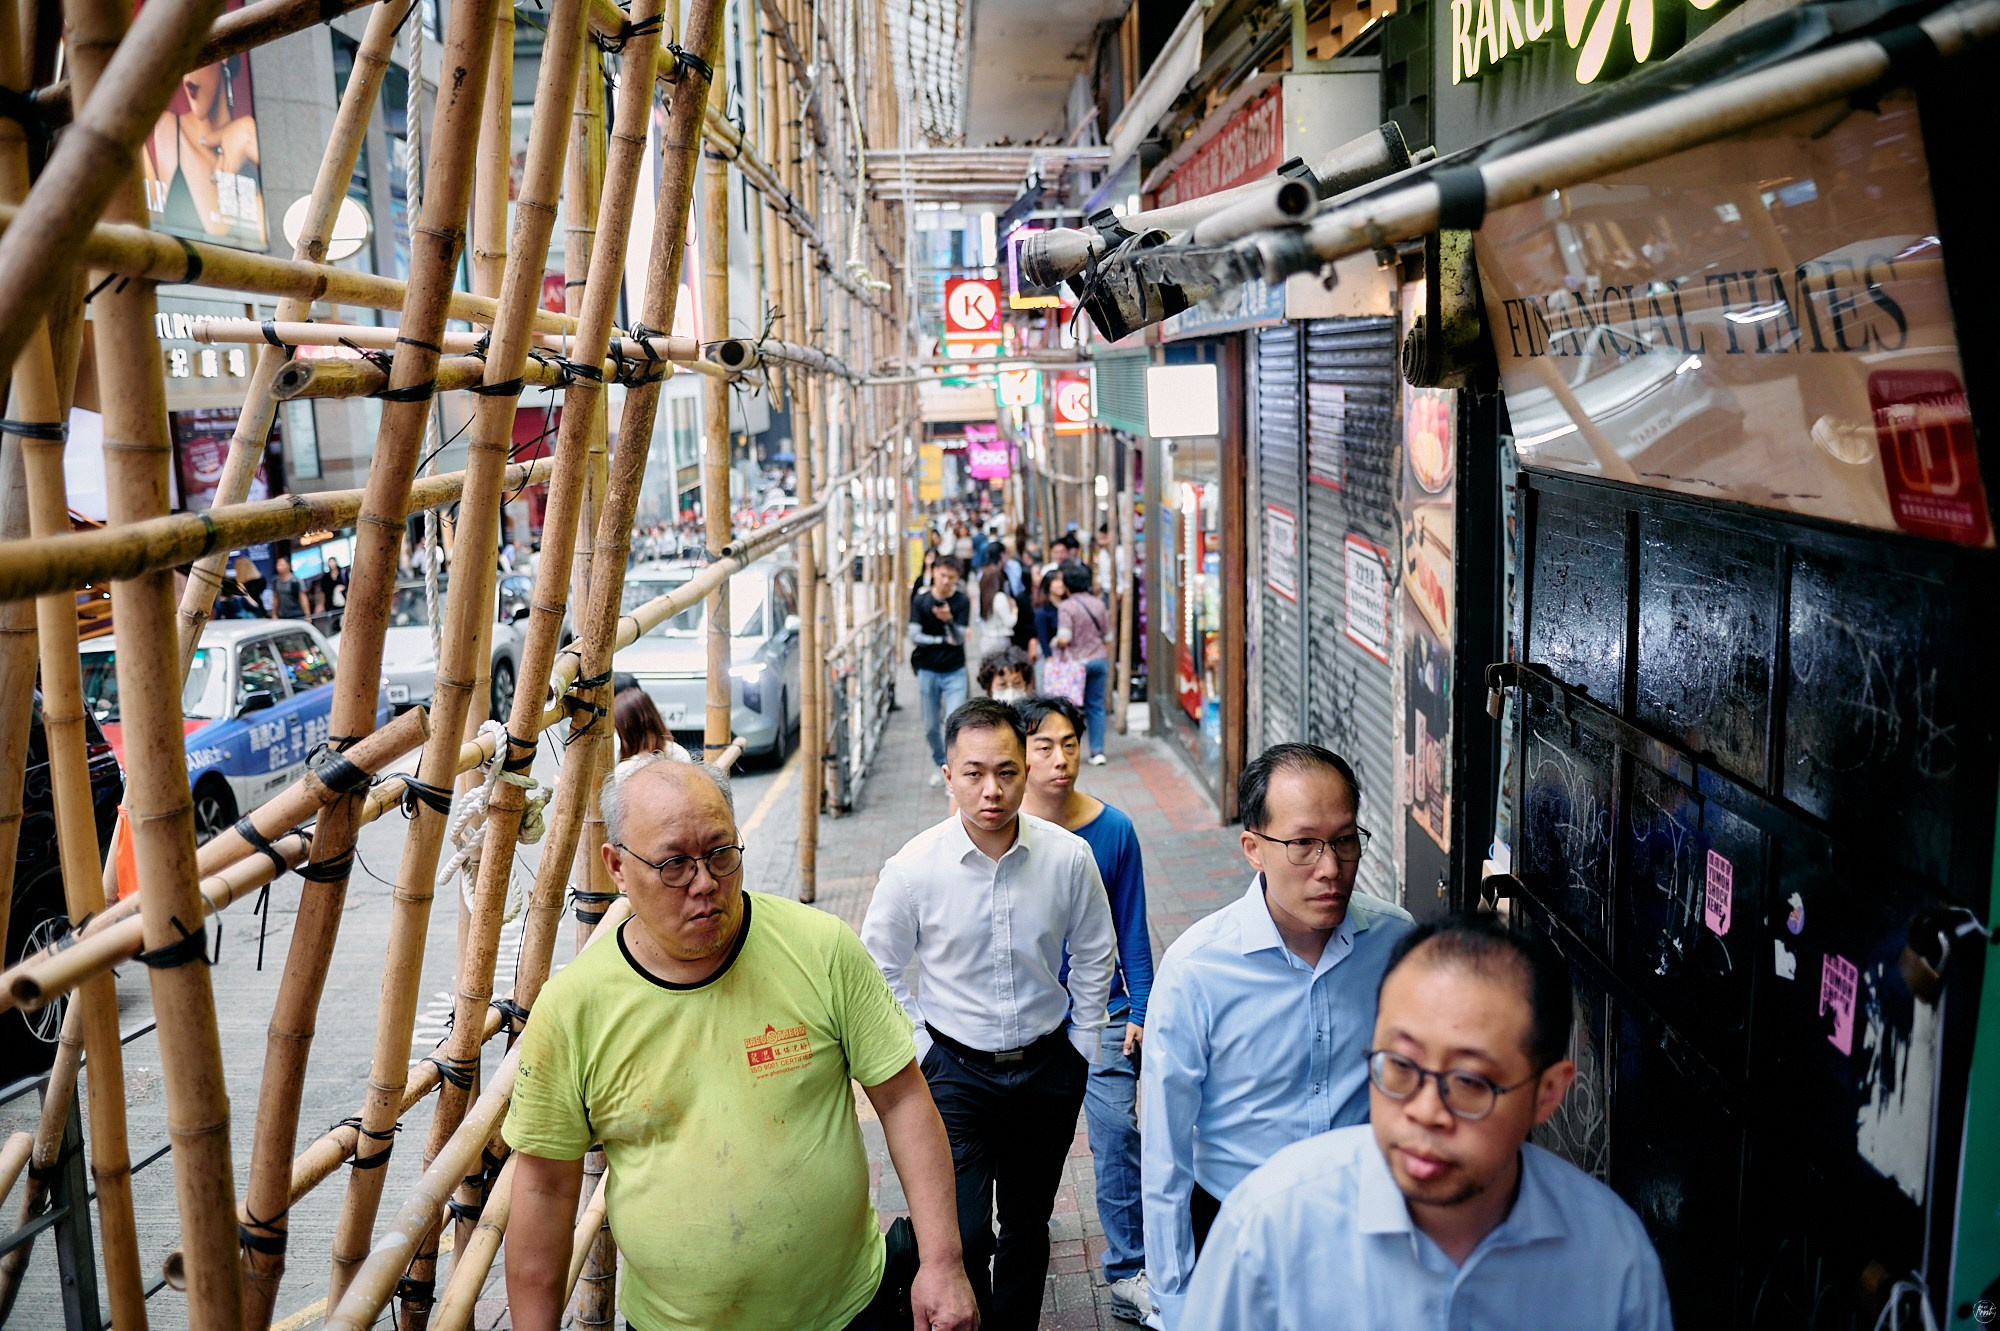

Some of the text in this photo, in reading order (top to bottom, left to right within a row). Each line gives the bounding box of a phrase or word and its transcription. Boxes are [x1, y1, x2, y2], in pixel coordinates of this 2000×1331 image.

[1503, 254, 1908, 358] FINANCIAL TIMES
[1708, 865, 1731, 888] YUMOH
[1707, 881, 1729, 905] SHOCK
